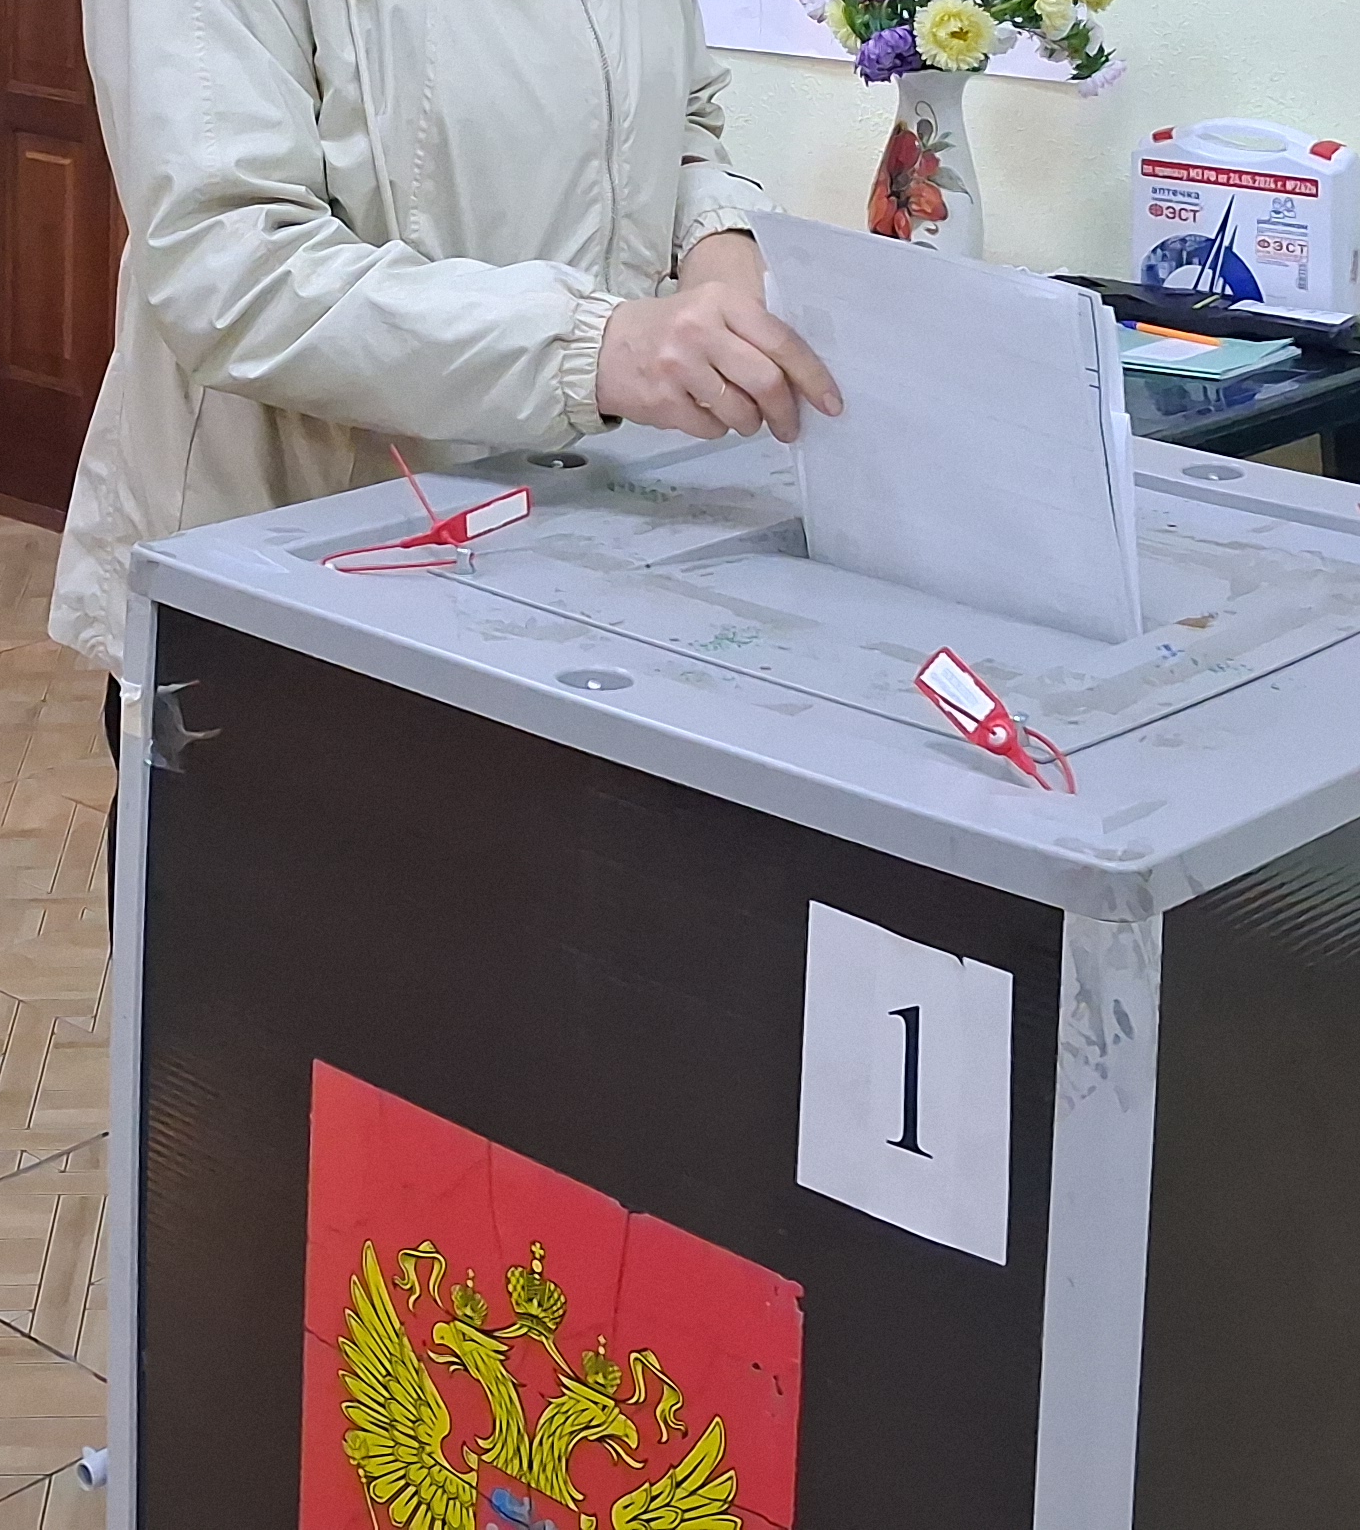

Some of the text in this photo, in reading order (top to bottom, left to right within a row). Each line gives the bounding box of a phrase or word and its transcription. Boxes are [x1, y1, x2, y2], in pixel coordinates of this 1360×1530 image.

[1203, 170, 1217, 182] РФ
[1151, 186, 1200, 200] аптечка
[1148, 203, 1201, 223] ФЭСТ
[1257, 238, 1308, 255] ФЭСТ
[886, 1005, 934, 1160] 1
